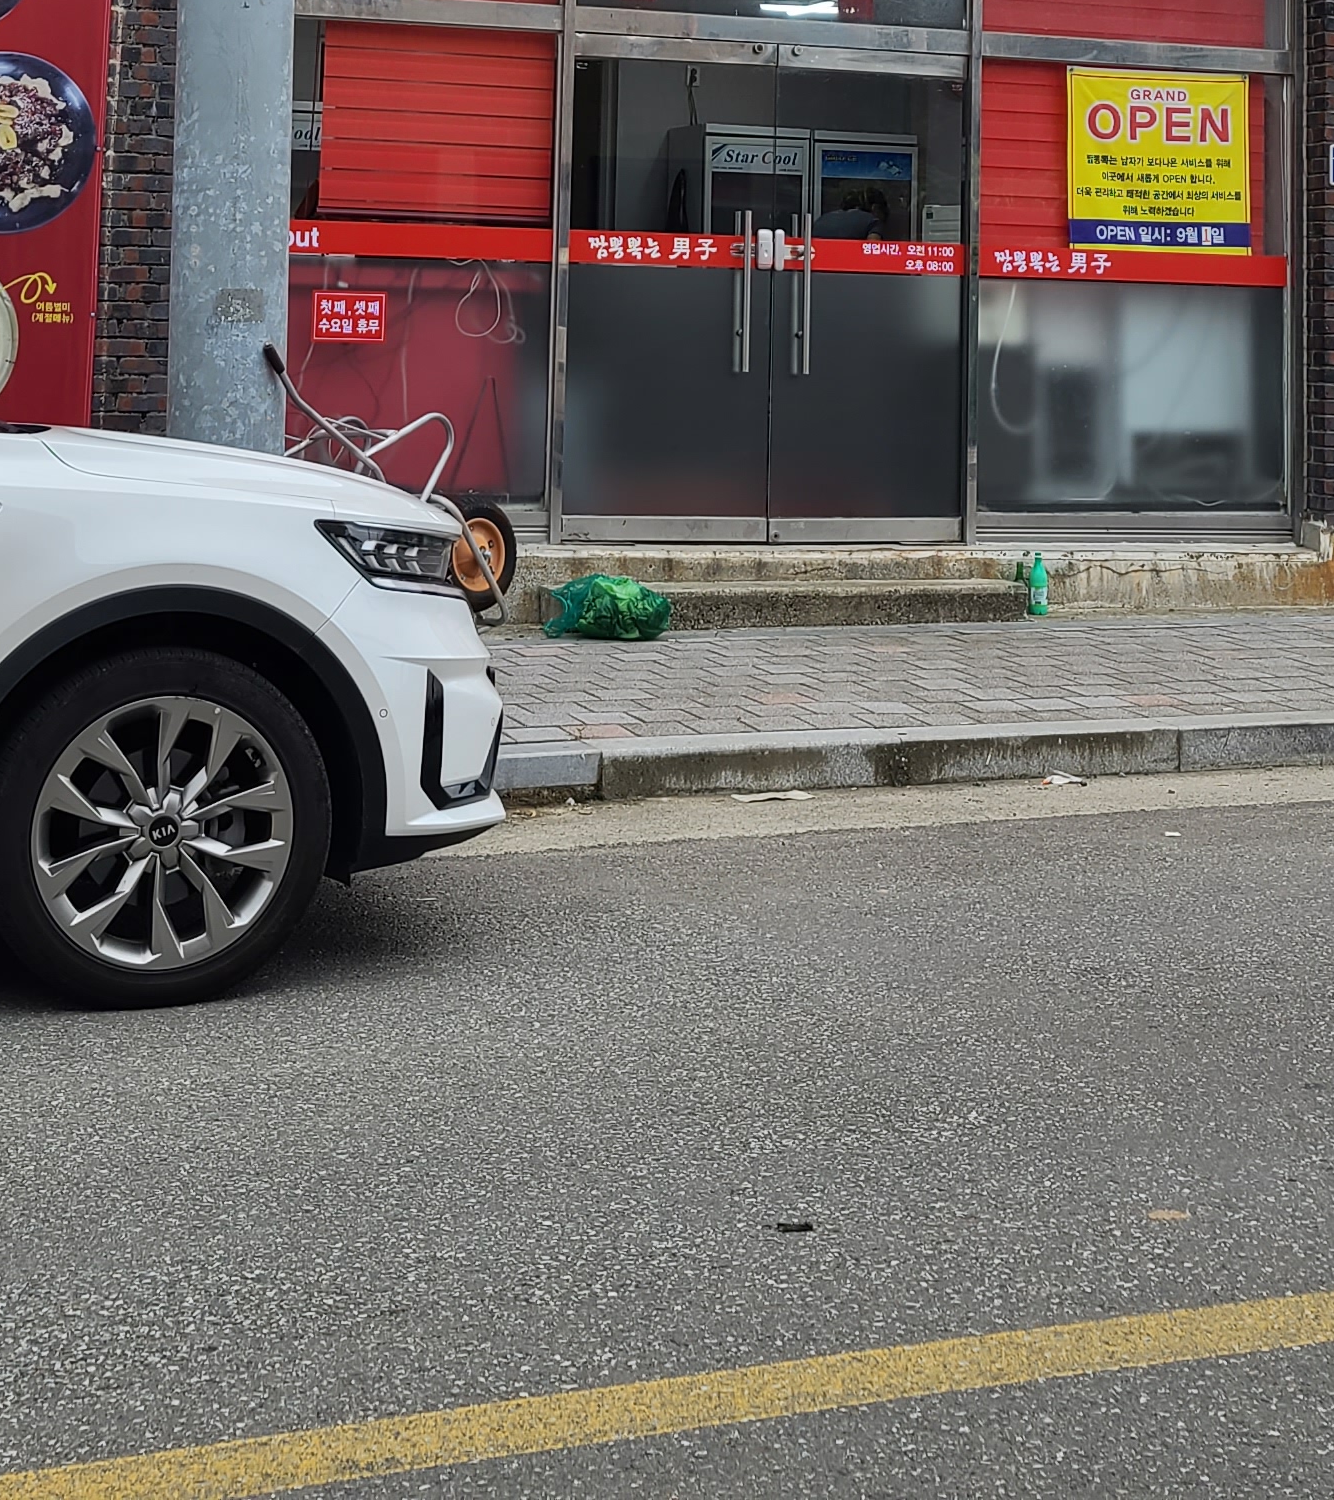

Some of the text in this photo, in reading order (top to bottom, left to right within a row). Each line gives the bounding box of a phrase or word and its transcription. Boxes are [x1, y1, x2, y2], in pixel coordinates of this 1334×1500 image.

[1130, 88, 1188, 102] GRAND
[1087, 102, 1230, 143] OPEN
[292, 126, 321, 141] ool
[724, 149, 798, 166] Star Cool
[1163, 174, 1187, 184] OPEN
[1076, 186, 1092, 197] 더욱
[1096, 225, 1136, 241] OPEN
[1139, 226, 1171, 243] 일시:
[1176, 226, 1199, 244] 9월
[668, 237, 718, 260] 男子
[907, 244, 925, 257] 오전
[927, 246, 955, 257] 11:00
[905, 259, 954, 272] 오후 08:00
[1067, 252, 1112, 275] 男子
[35, 301, 71, 313] 여름별미
[353, 300, 380, 317] 셋째
[31, 312, 74, 324] (계절메뉴)
[318, 318, 380, 334] 수요일 휴무
[152, 824, 176, 841] KIA
